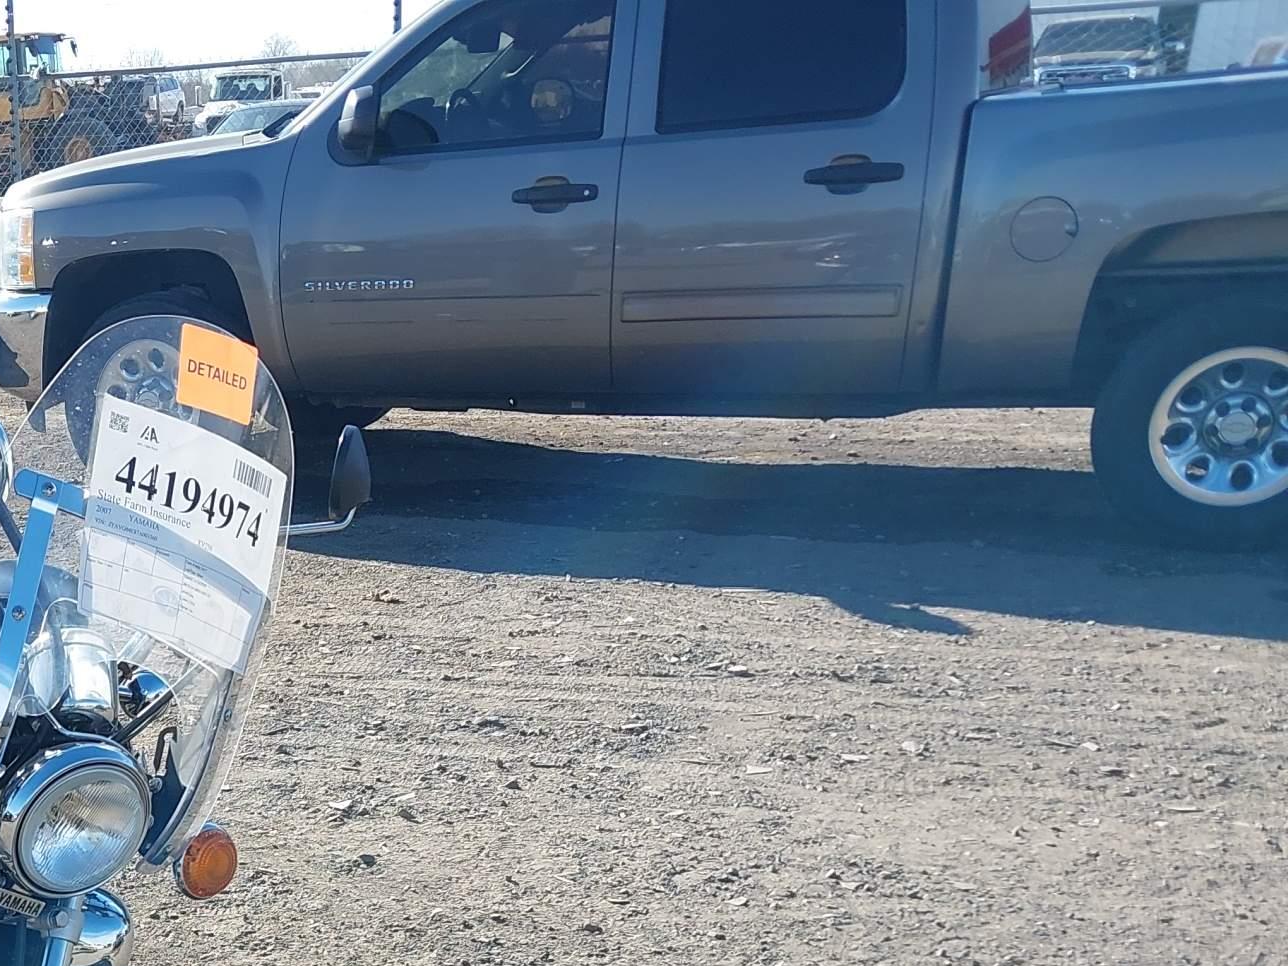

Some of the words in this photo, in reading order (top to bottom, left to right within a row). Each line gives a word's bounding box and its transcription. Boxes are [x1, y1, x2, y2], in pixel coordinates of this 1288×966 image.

[304, 279, 414, 292] SILVERADO
[187, 359, 247, 390] DETAILED
[95, 504, 112, 515] 2007
[128, 514, 160, 531] YAMAHA
[97, 488, 121, 506] State
[123, 496, 147, 514] Farm
[150, 505, 192, 529] Insurance
[115, 456, 263, 548] 44194974
